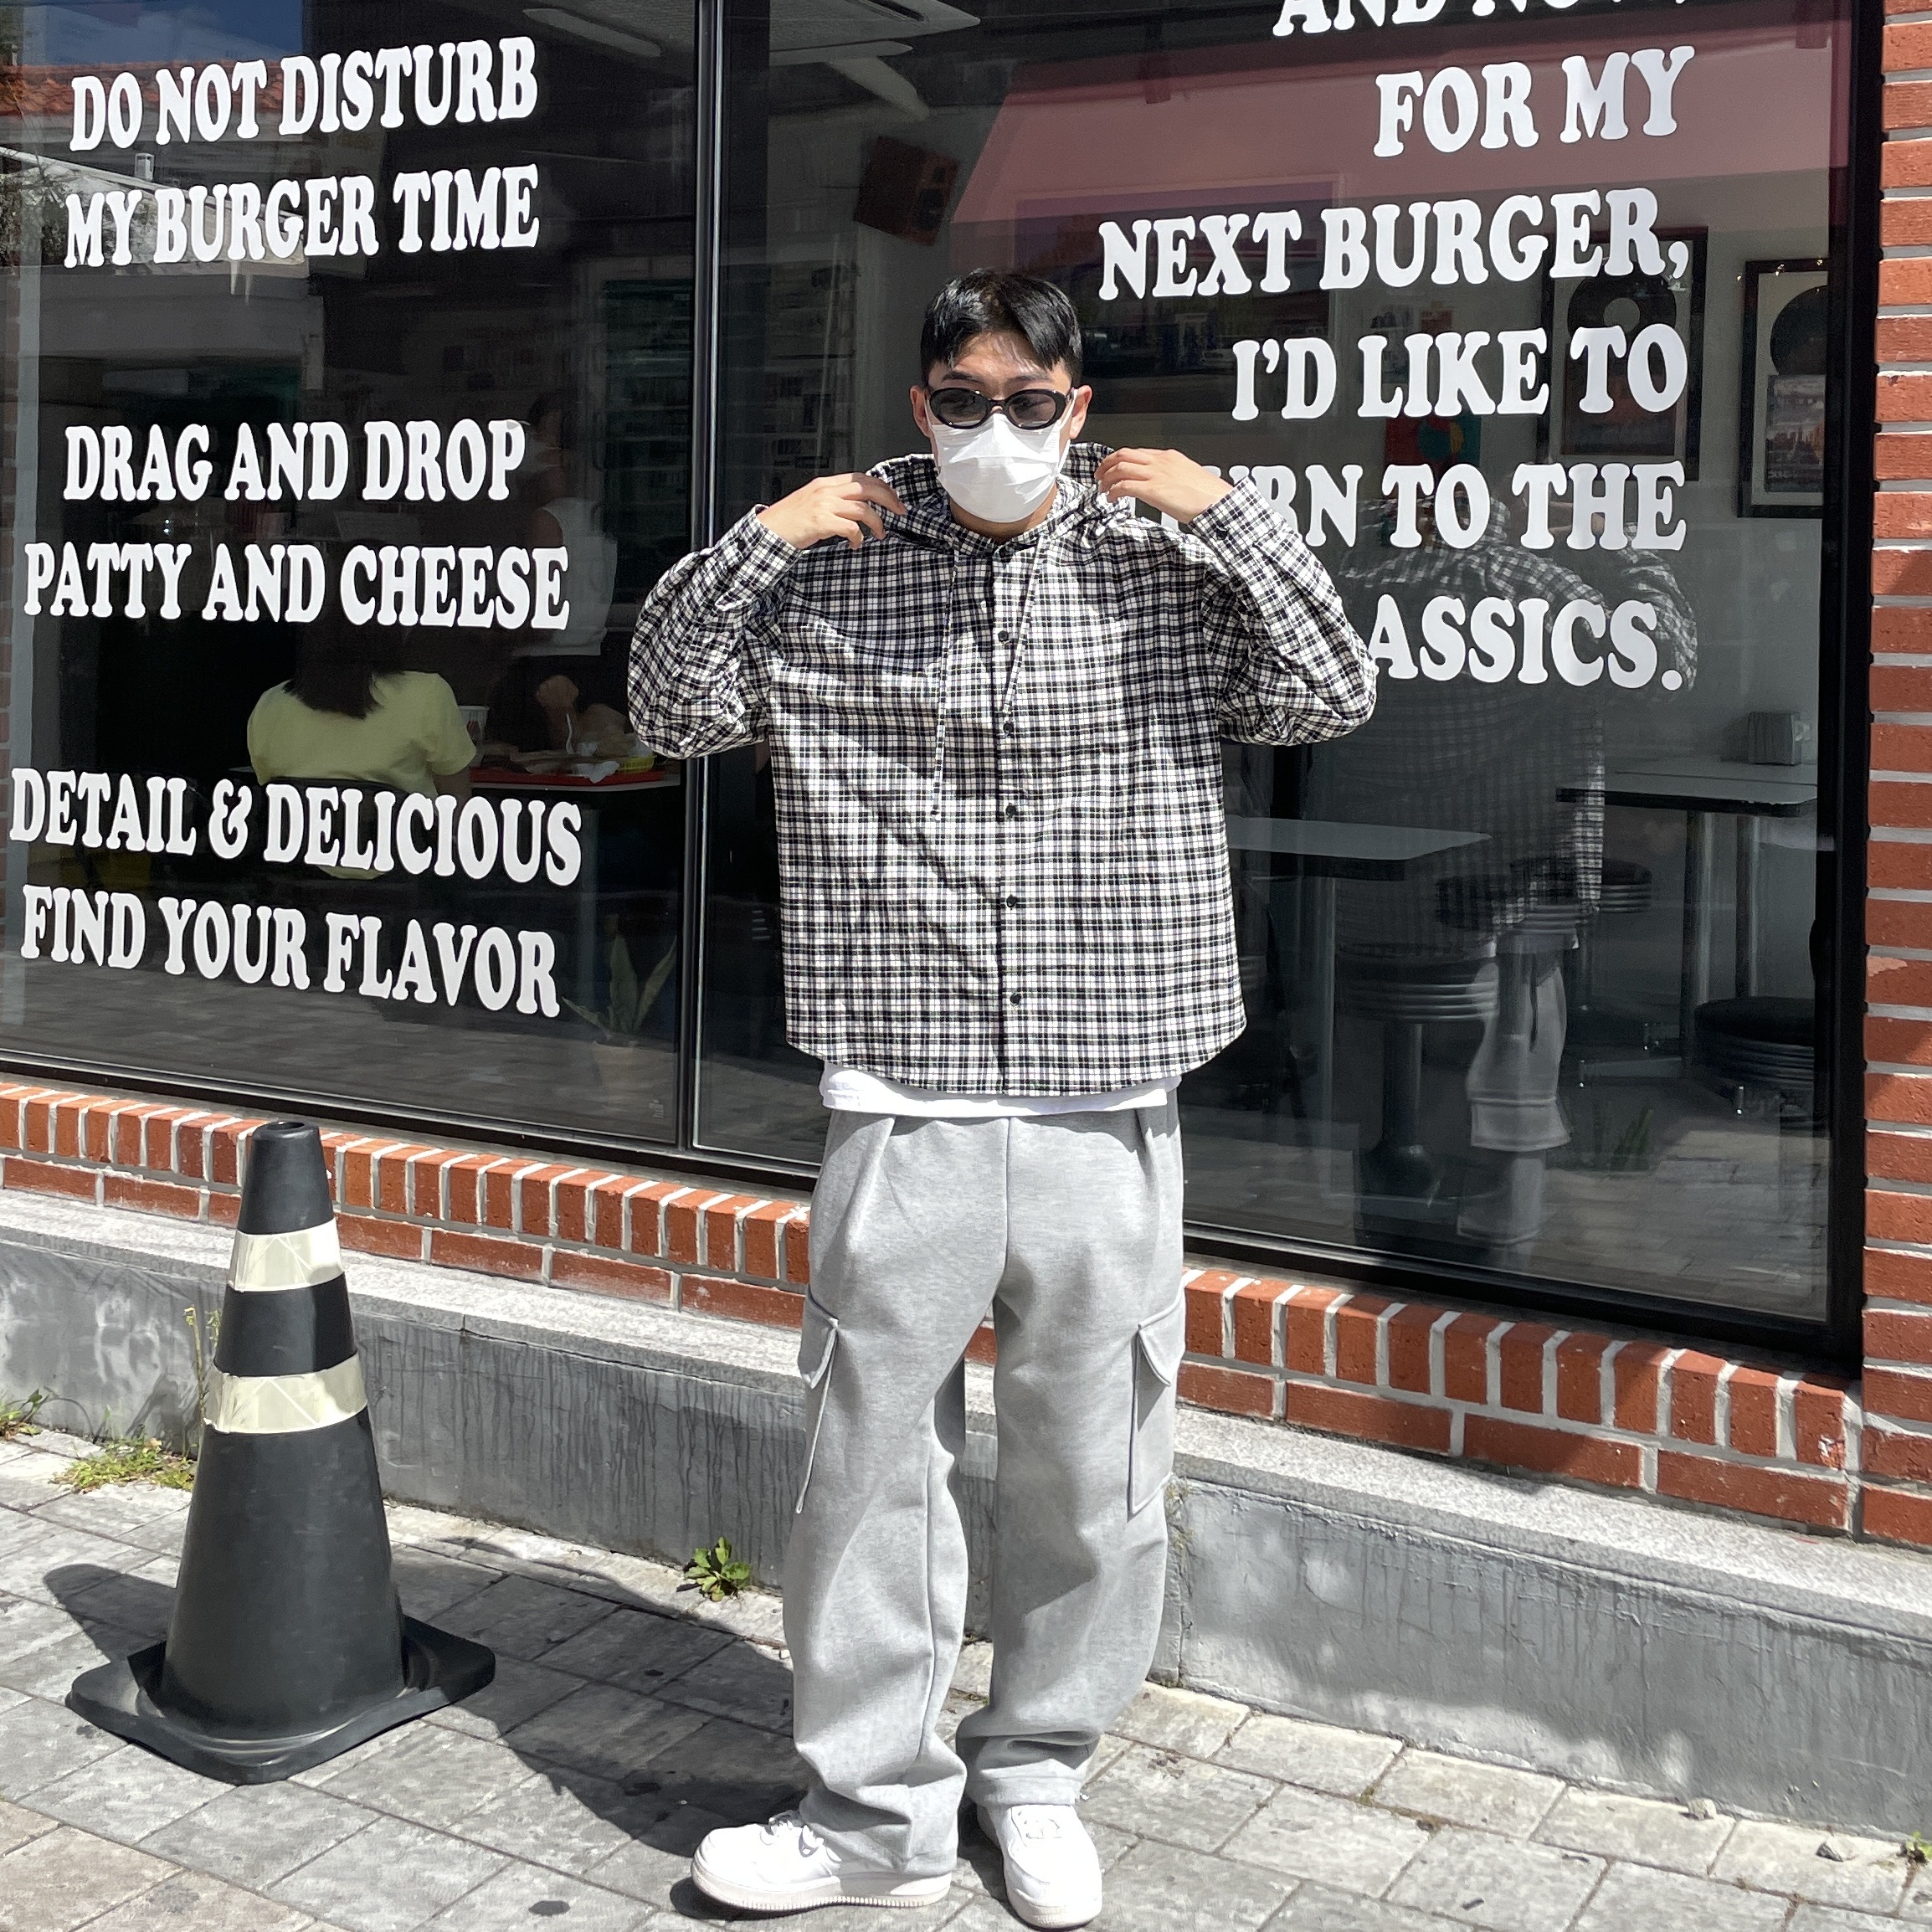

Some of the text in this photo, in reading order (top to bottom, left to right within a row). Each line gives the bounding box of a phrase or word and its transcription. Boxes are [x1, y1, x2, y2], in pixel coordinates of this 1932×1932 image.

[69, 36, 538, 152] DO NOT DISTURB
[1373, 45, 1695, 157] FOR MY
[64, 163, 540, 269] MY BURGER TIME
[1098, 188, 1689, 301] NEXT BURGER,
[1231, 323, 1688, 421] I'D LIKE TO
[63, 419, 526, 502] DRAG AND DROP
[1381, 463, 1491, 549] TO
[1511, 460, 1687, 551] THE
[23, 541, 570, 630] PATTY AND CHEESE
[1351, 593, 1683, 691] ASSICS.
[9, 768, 582, 886] DETAIL & DELICIOUS
[20, 884, 560, 1018] FIND YOUR FLAVOR
